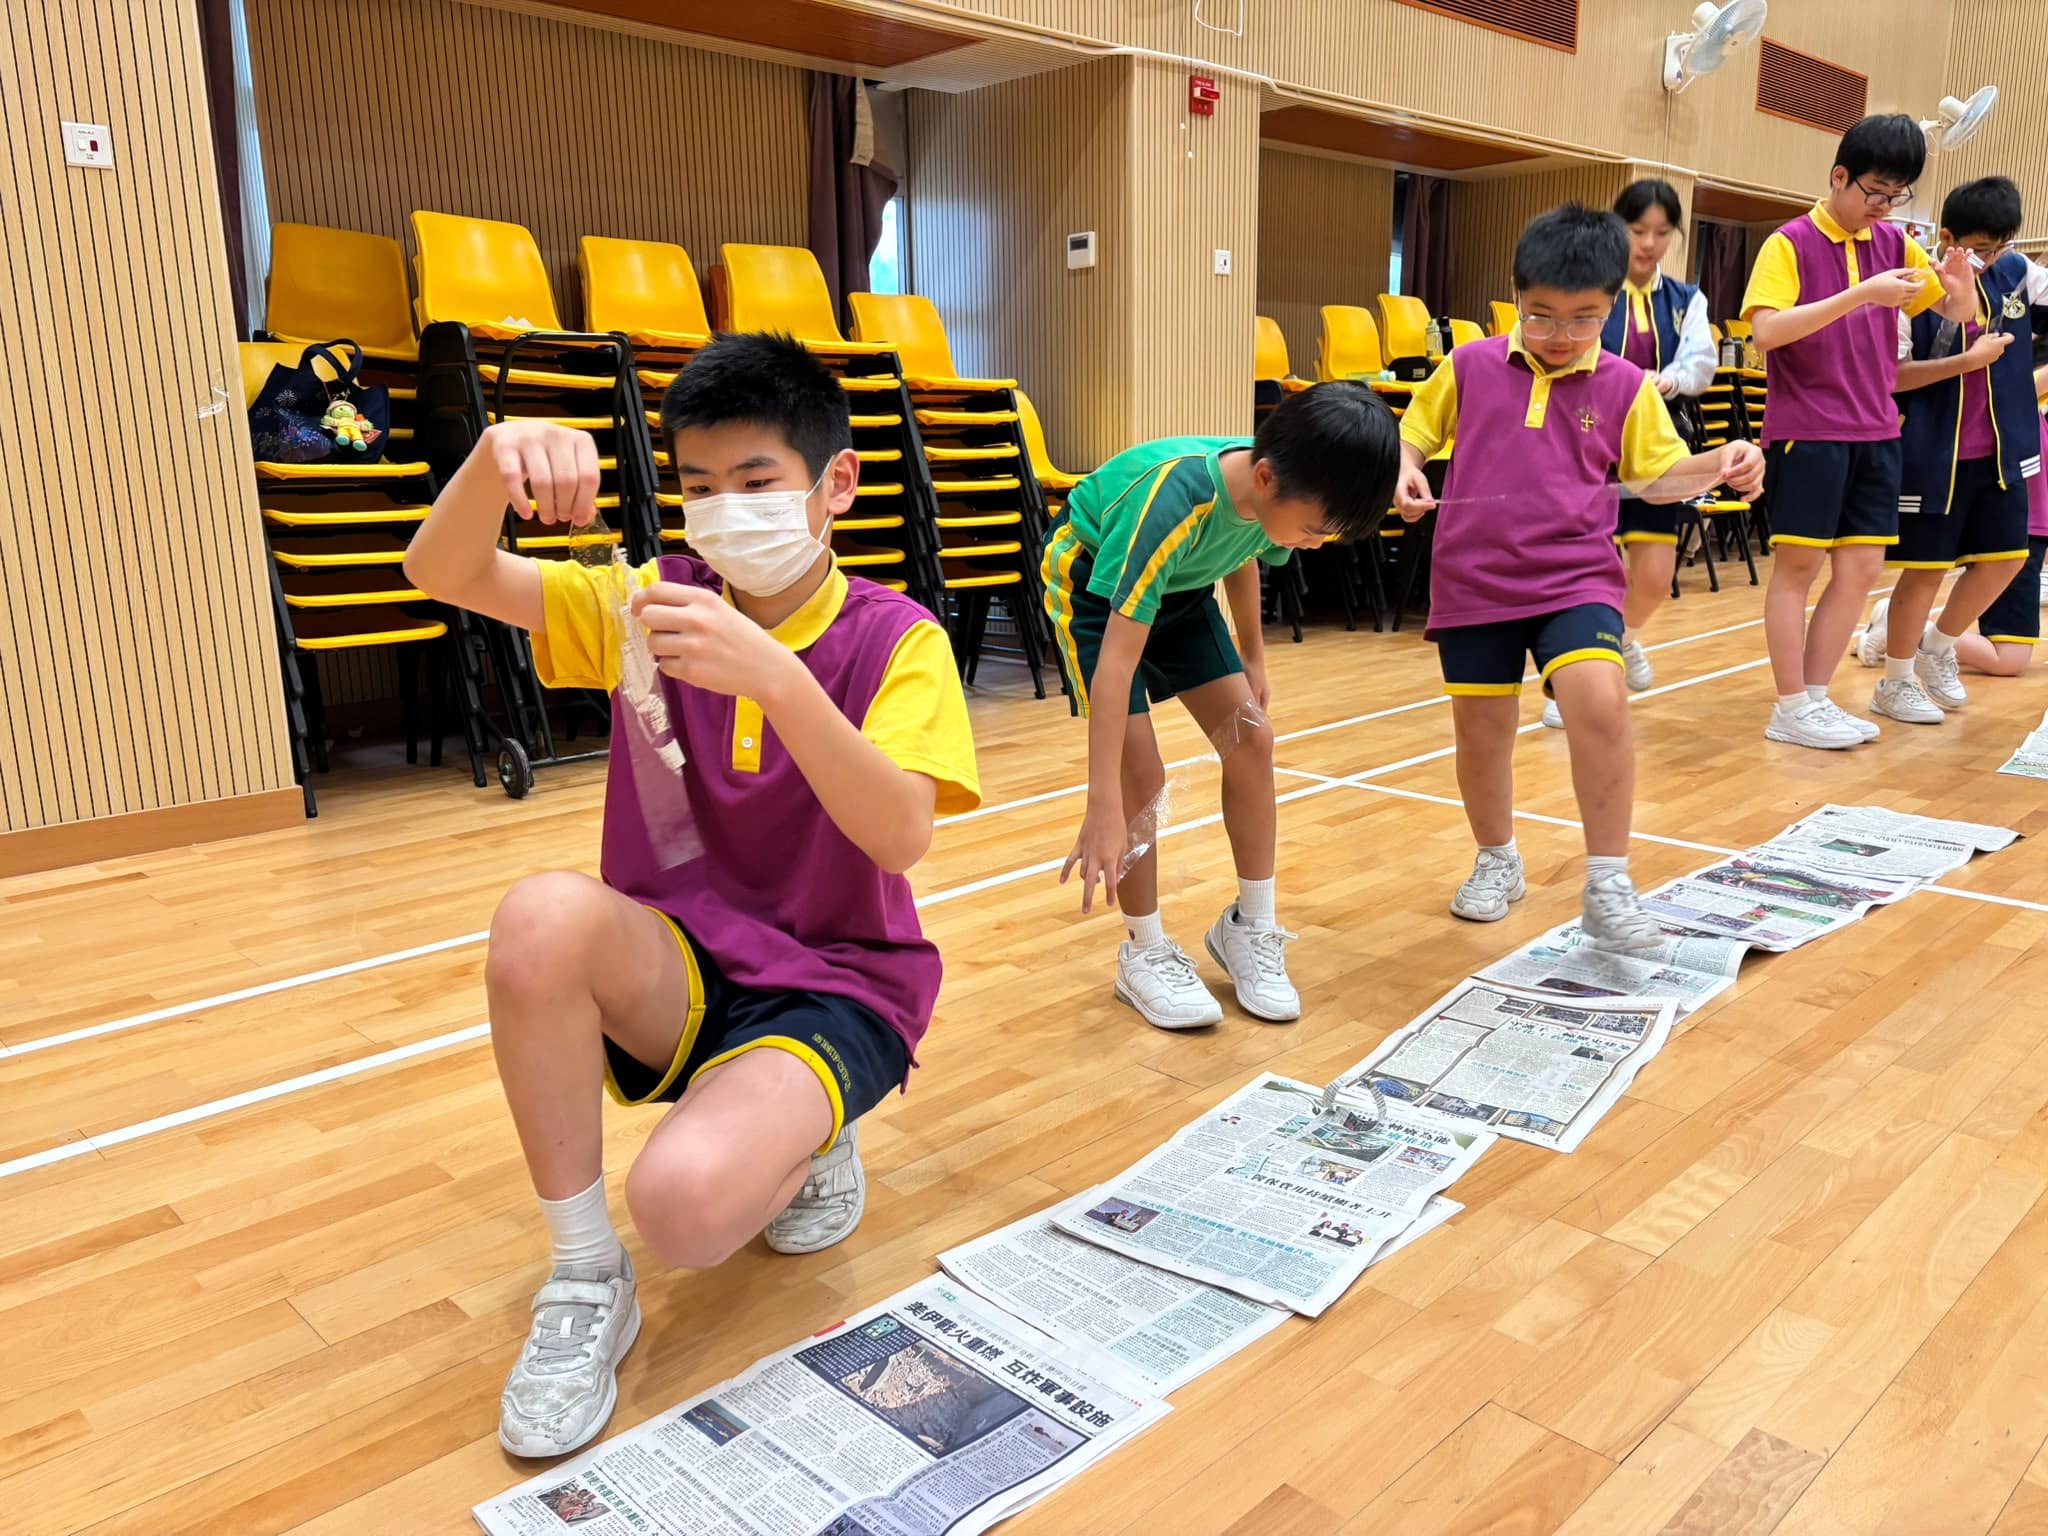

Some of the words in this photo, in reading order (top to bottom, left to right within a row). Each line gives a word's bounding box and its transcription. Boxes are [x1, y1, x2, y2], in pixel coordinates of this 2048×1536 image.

[904, 1301, 1004, 1362] 美伊戰火重燃
[1001, 1358, 1115, 1428] 互炸軍事設施
